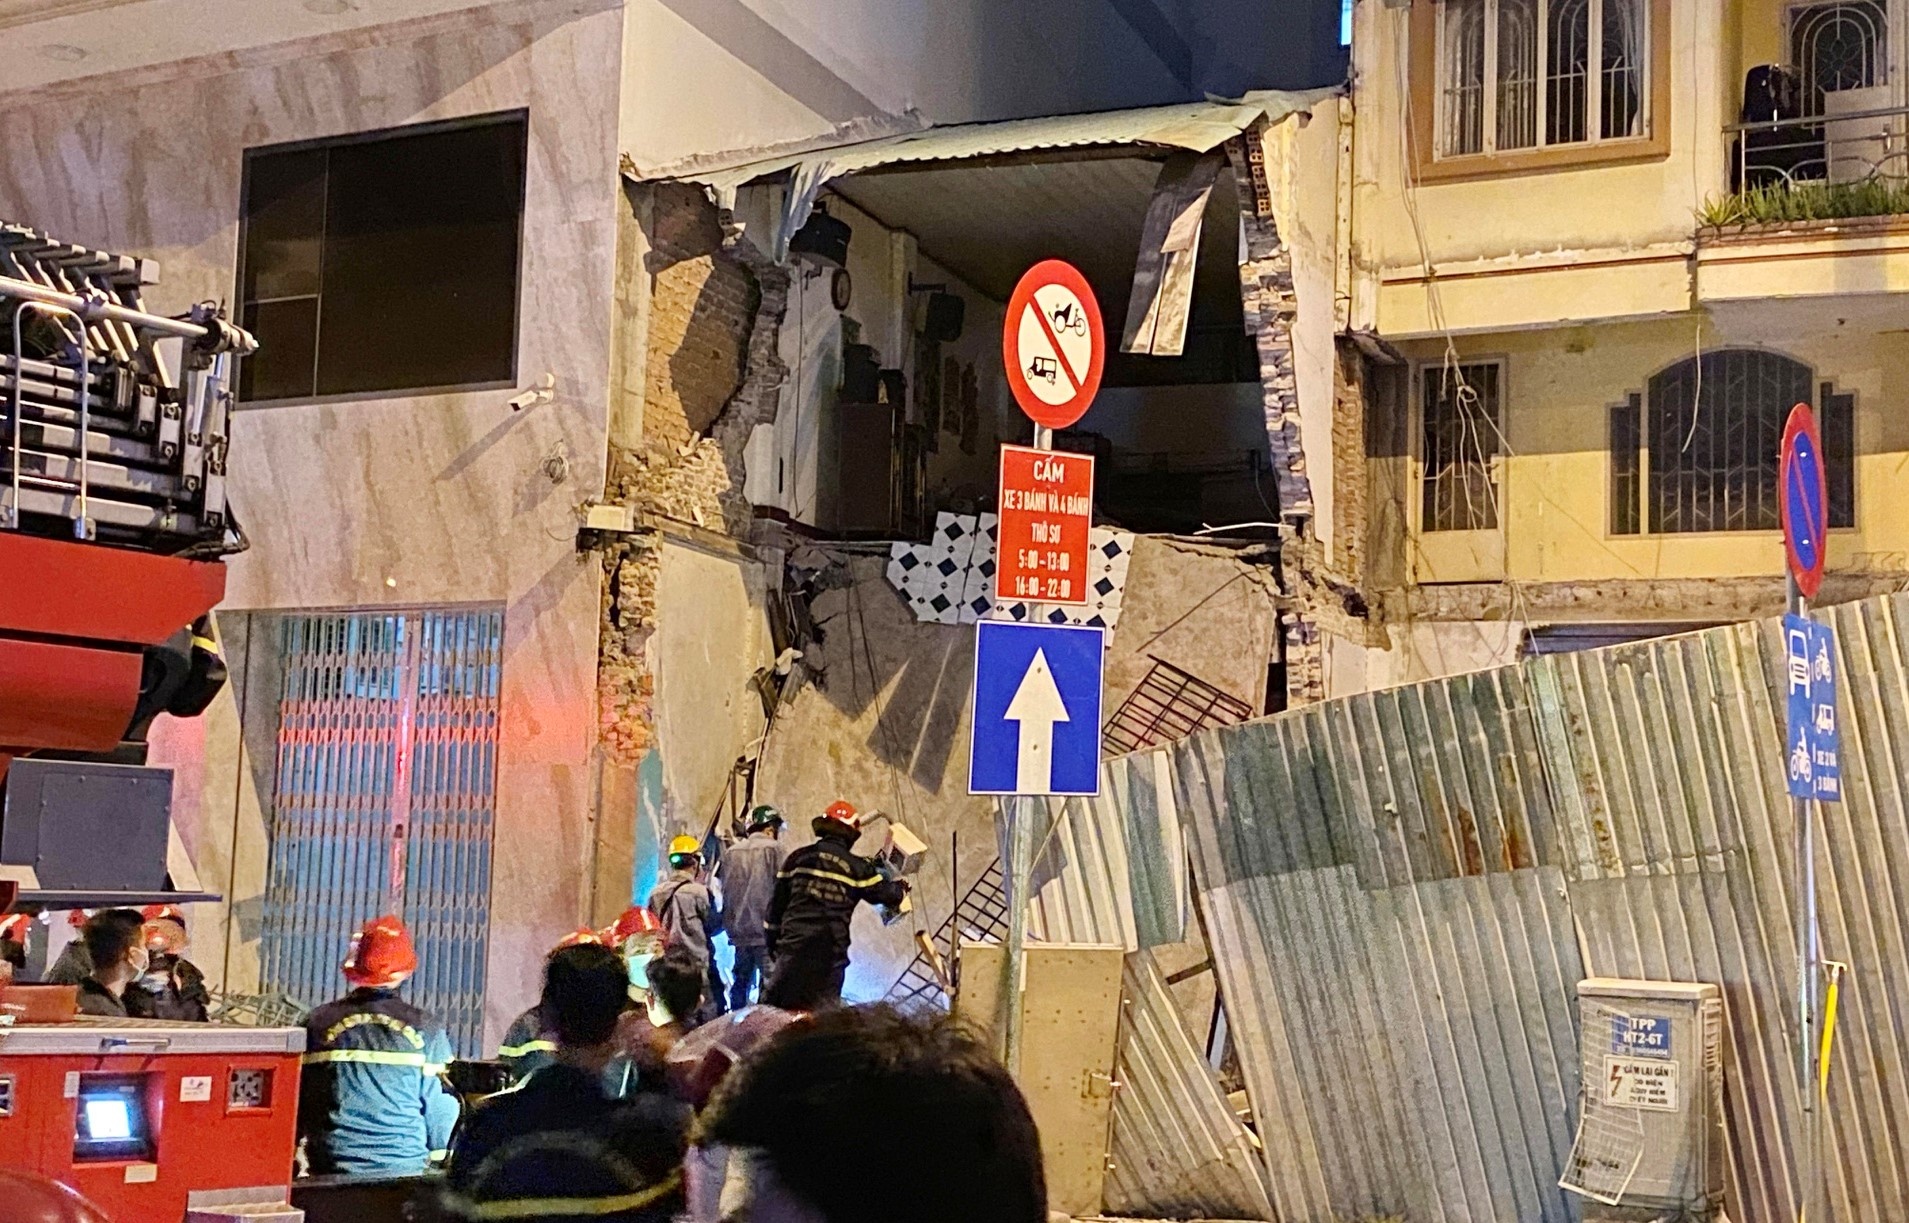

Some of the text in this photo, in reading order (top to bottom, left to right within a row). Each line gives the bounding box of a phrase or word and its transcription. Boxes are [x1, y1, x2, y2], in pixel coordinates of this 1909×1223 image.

[1033, 454, 1065, 484] CẤM
[1003, 487, 1090, 517] XE 3 BÁNH VÀ 4 BÁNH
[1031, 520, 1061, 545] THÔ SƠ
[1631, 1017, 1656, 1031] TPP
